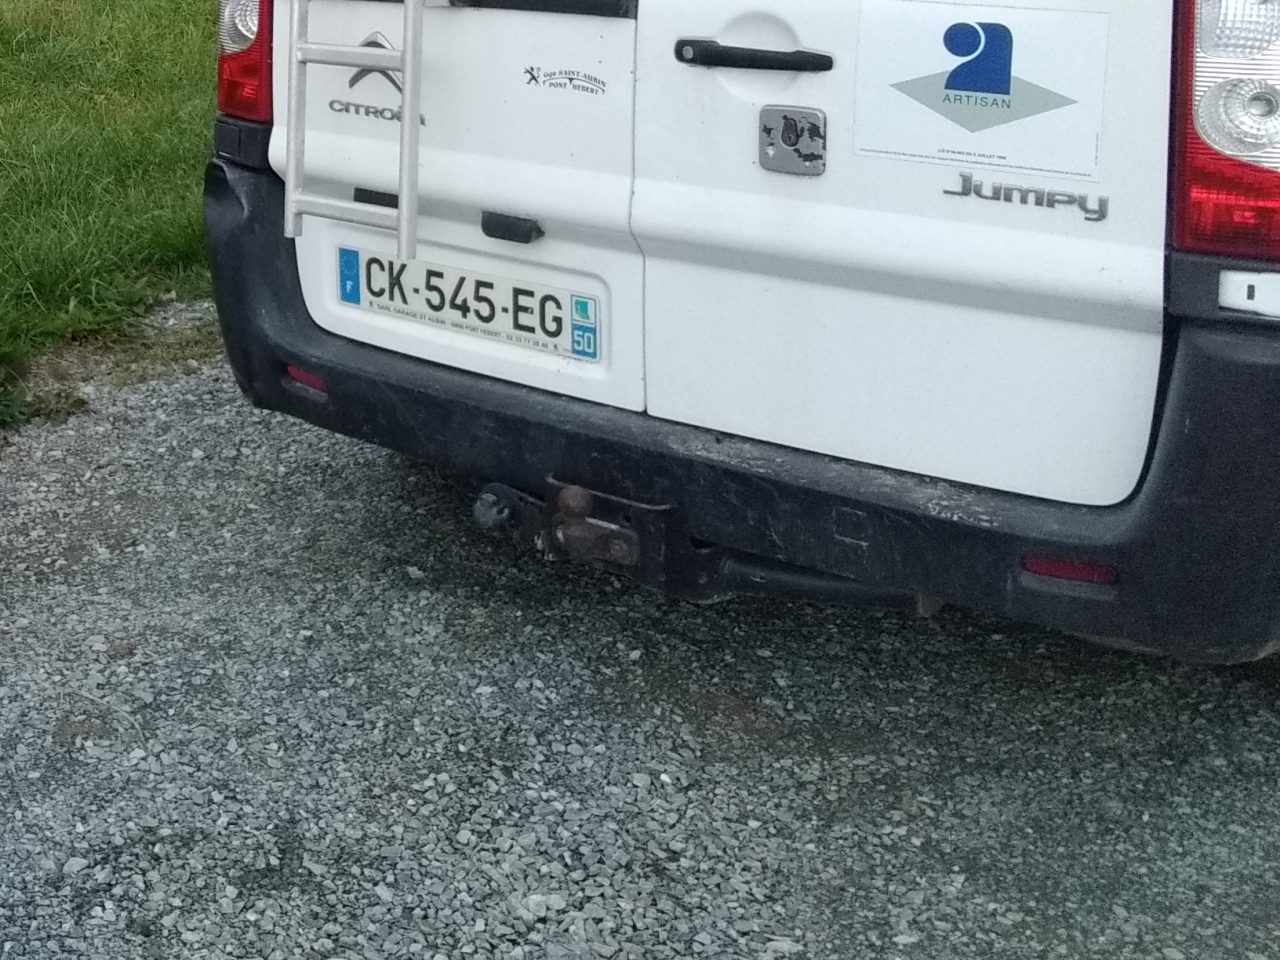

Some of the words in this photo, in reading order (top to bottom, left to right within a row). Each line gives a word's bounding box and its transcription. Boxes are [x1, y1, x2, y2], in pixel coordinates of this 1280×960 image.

[548, 81, 568, 90] PONT
[328, 99, 426, 126] CITRO
[942, 93, 1011, 109] ARTISAN
[942, 170, 1110, 222] Jumpy
[365, 256, 564, 339] CK-545-EG
[573, 330, 594, 353] 50
